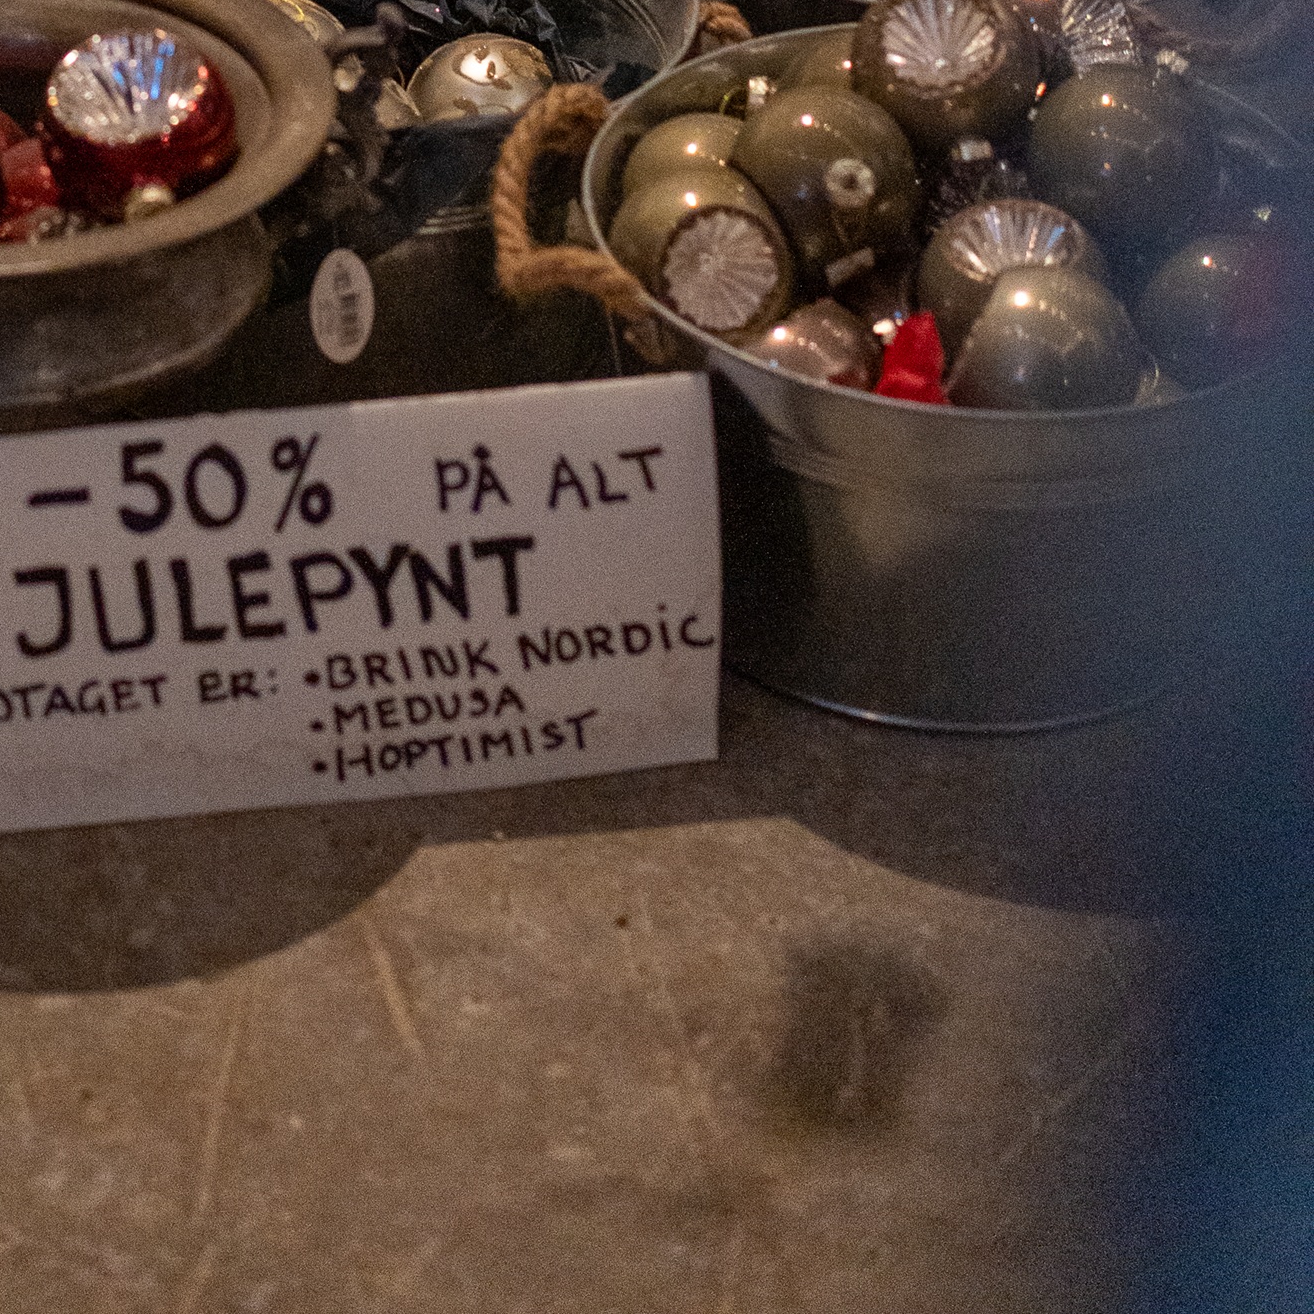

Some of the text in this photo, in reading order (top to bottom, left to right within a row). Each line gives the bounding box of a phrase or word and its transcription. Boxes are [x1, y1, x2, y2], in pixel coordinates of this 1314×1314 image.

[27, 431, 665, 535] -50% PÅ ALT
[14, 534, 536, 660] JULEPYNT
[325, 637, 500, 692] BRINK
[332, 683, 527, 735] MEDUSA
[335, 708, 599, 783] HOPTIMIST
